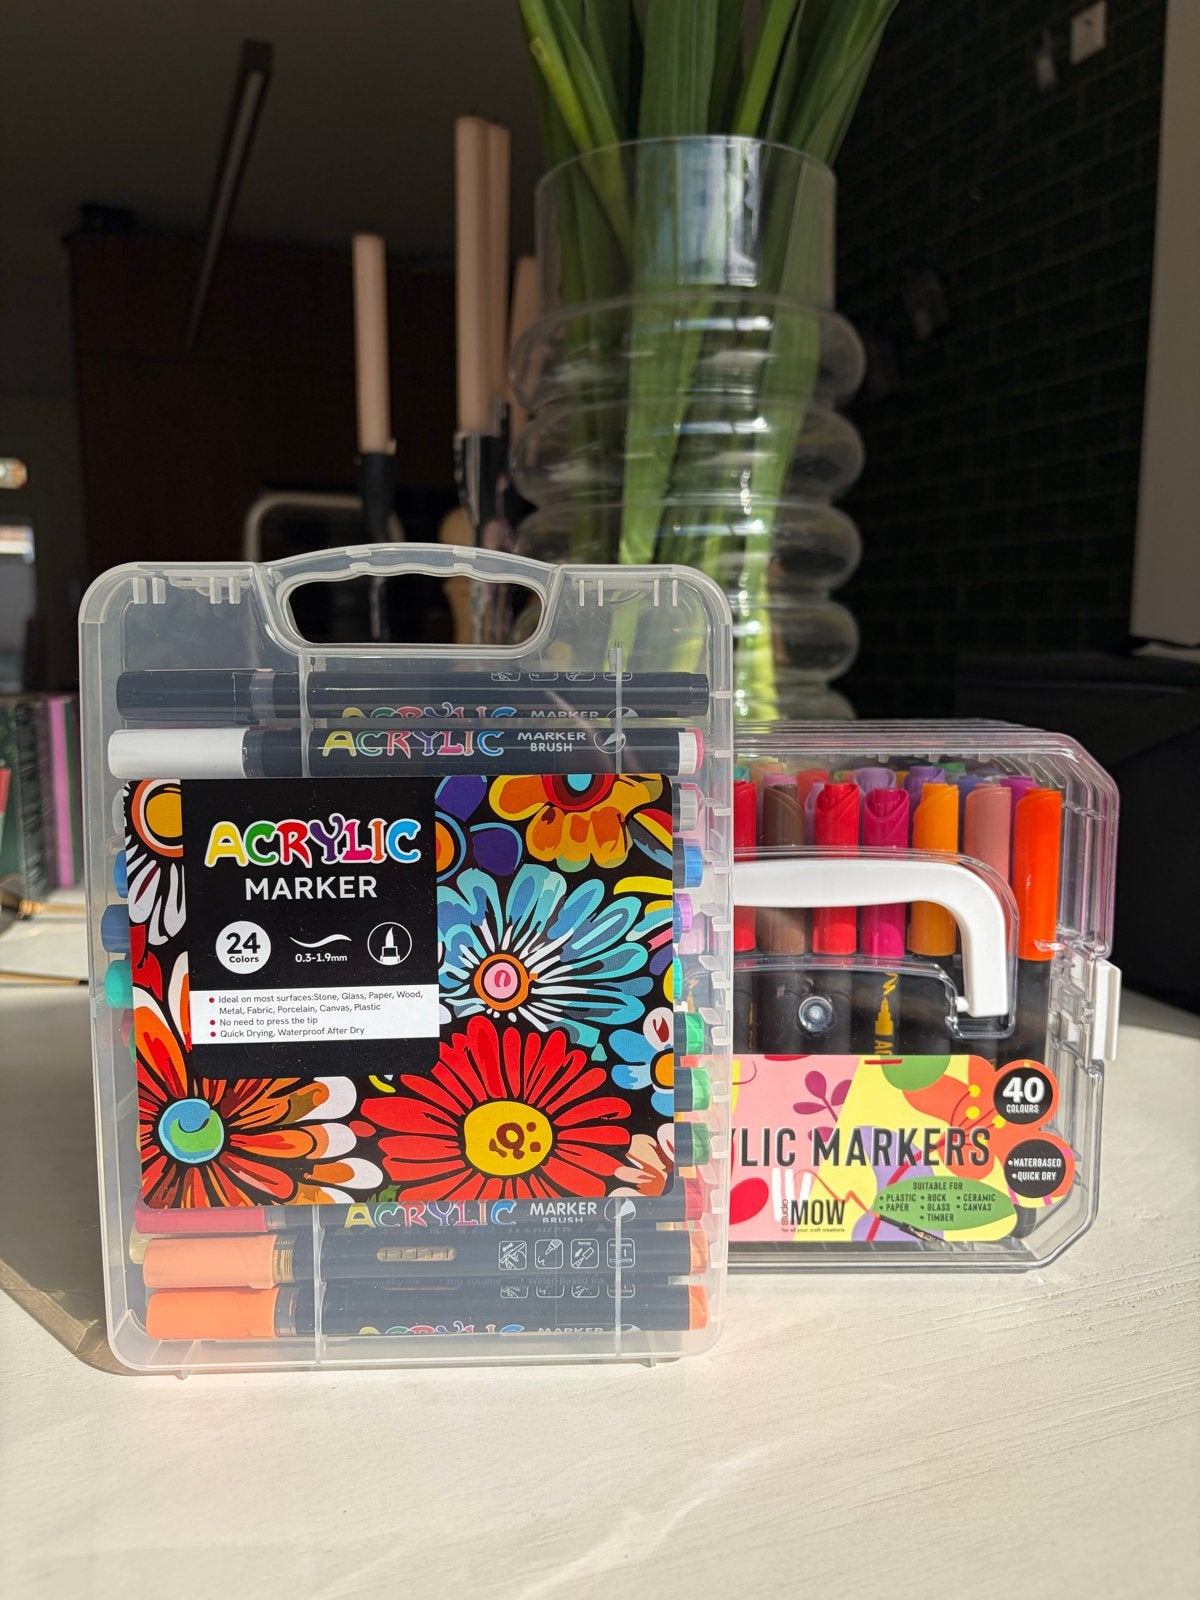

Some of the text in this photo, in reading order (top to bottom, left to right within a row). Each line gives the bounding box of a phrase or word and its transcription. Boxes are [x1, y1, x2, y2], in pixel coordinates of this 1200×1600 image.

[321, 730, 587, 760] ACRYLIC MARKER
[530, 742, 573, 752] BRUSH
[204, 812, 422, 869] ACRYLIC
[245, 875, 378, 901] MARKER
[225, 931, 261, 955] 24
[228, 955, 259, 964] Colors
[295, 952, 348, 963] 0.3-1.9mm
[218, 995, 239, 1004] Ideal
[253, 995, 275, 1003] most
[341, 991, 367, 1001] Glass,
[368, 991, 395, 1001] Paper,
[396, 990, 423, 999] Wood,
[219, 1002, 382, 1015] Metal, Fabric, Porcelain, Canvas, Plastic
[219, 1018, 232, 1026] No
[233, 1018, 254, 1026] need
[266, 1018, 290, 1027] press
[291, 1016, 305, 1024] the
[307, 1016, 319, 1025] tip
[220, 1026, 365, 1039] Quick Drying, Waterproof After Dry
[1002, 1076, 1045, 1104] 40
[1006, 1104, 1039, 1114] COLOURS
[731, 1126, 991, 1167] LIC MARKERS
[1013, 1158, 1062, 1168] WATERBASED
[1017, 1171, 1057, 1181] QUICK DRY
[913, 1181, 963, 1191] SUITABLE FOR
[886, 1193, 916, 1202] PLASTIC
[963, 1193, 996, 1202] CERAMIC
[790, 1199, 846, 1226] MOW
[886, 1203, 909, 1212] PAPER
[963, 1202, 992, 1212] CANVAS
[344, 1199, 598, 1228] ACRYLIC MARKER
[927, 1213, 954, 1222] TIMBER
[542, 1216, 584, 1224] BRUSH
